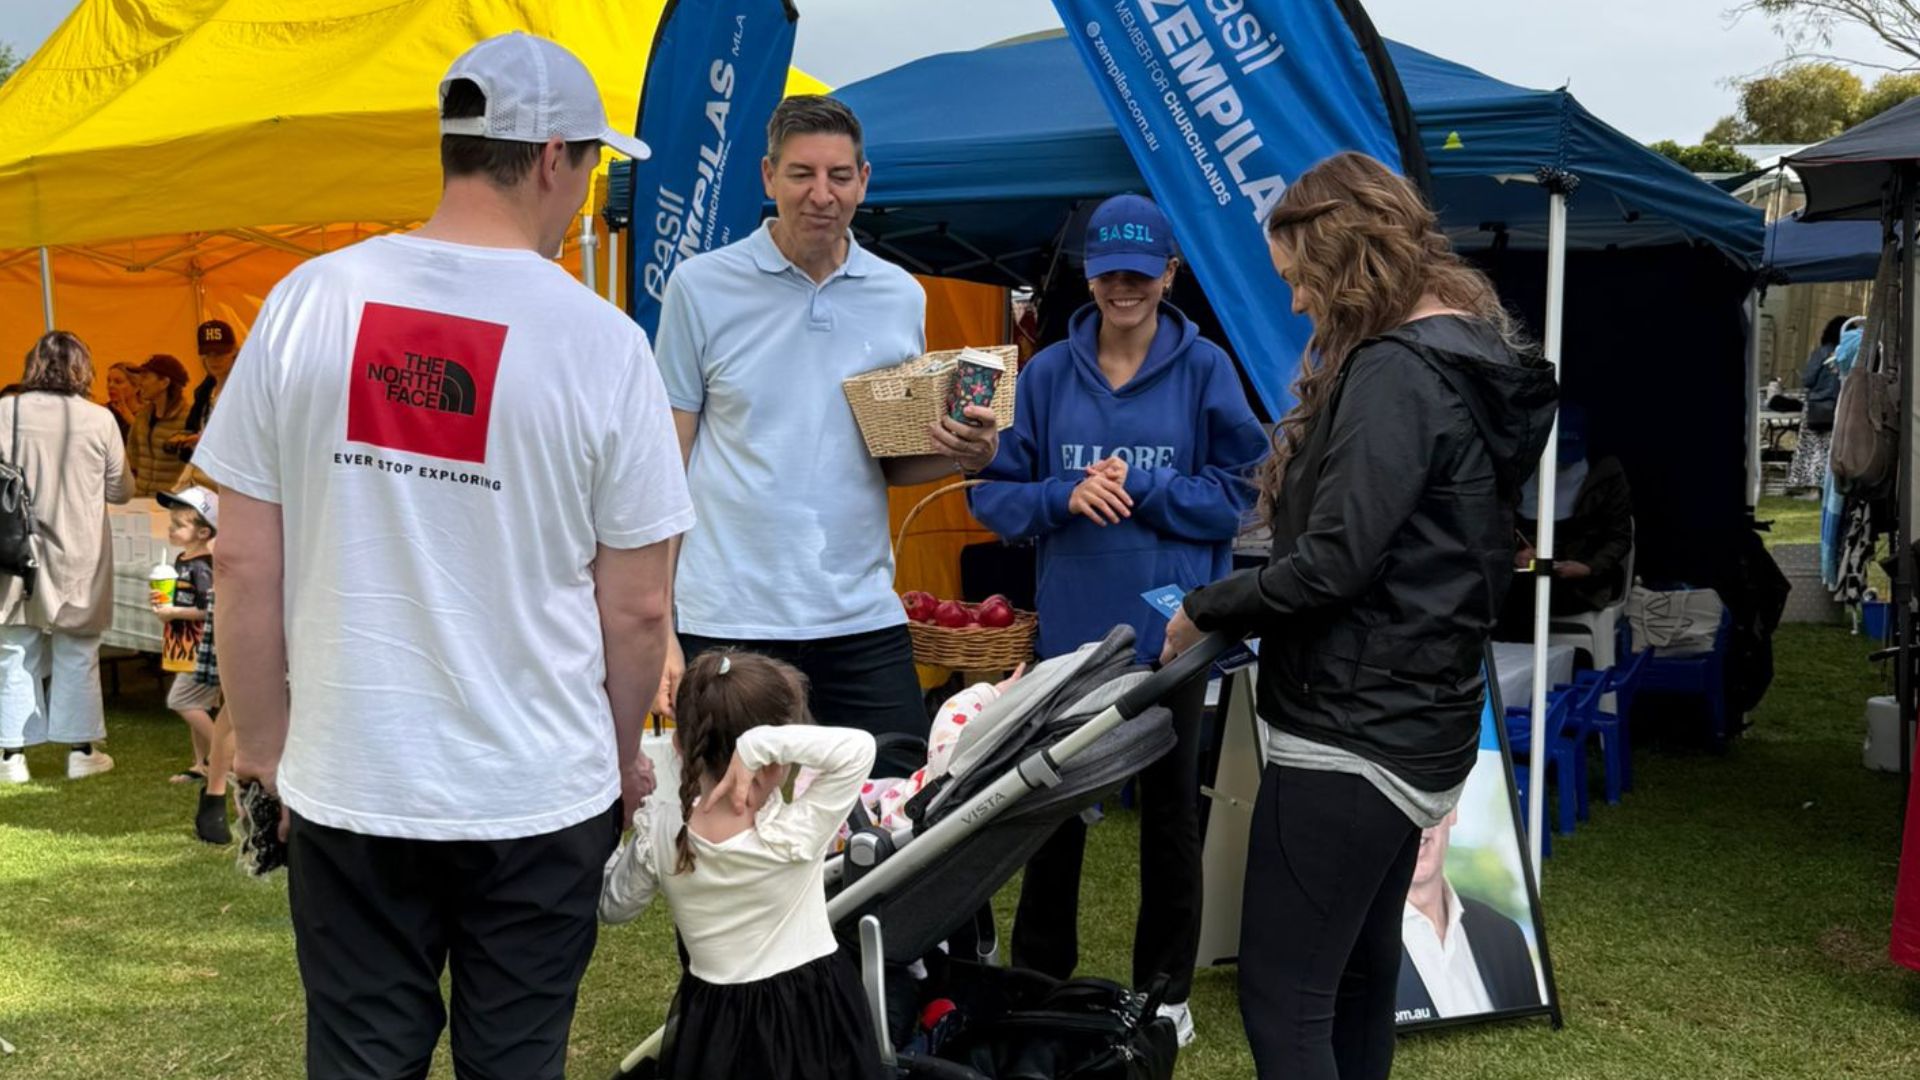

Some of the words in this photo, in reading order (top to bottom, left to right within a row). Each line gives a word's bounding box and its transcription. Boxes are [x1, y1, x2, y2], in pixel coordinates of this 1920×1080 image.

[1205, 0, 1285, 75] asil
[1094, 37, 1160, 152] zempilas.com.au
[1113, 0, 1153, 64] MEMBER
[1145, 60, 1170, 93] FOR
[1163, 91, 1232, 206] CHURCHLANDS
[675, 59, 735, 262] MPILAS
[731, 14, 747, 57] MLA
[1099, 223, 1154, 242] BASIL
[367, 363, 441, 391] NORTH
[404, 351, 445, 375] THE
[386, 384, 439, 410] FACE
[378, 459, 413, 474] STOP
[419, 467, 502, 491] EXPLORING
[961, 793, 1005, 825] VISTA
